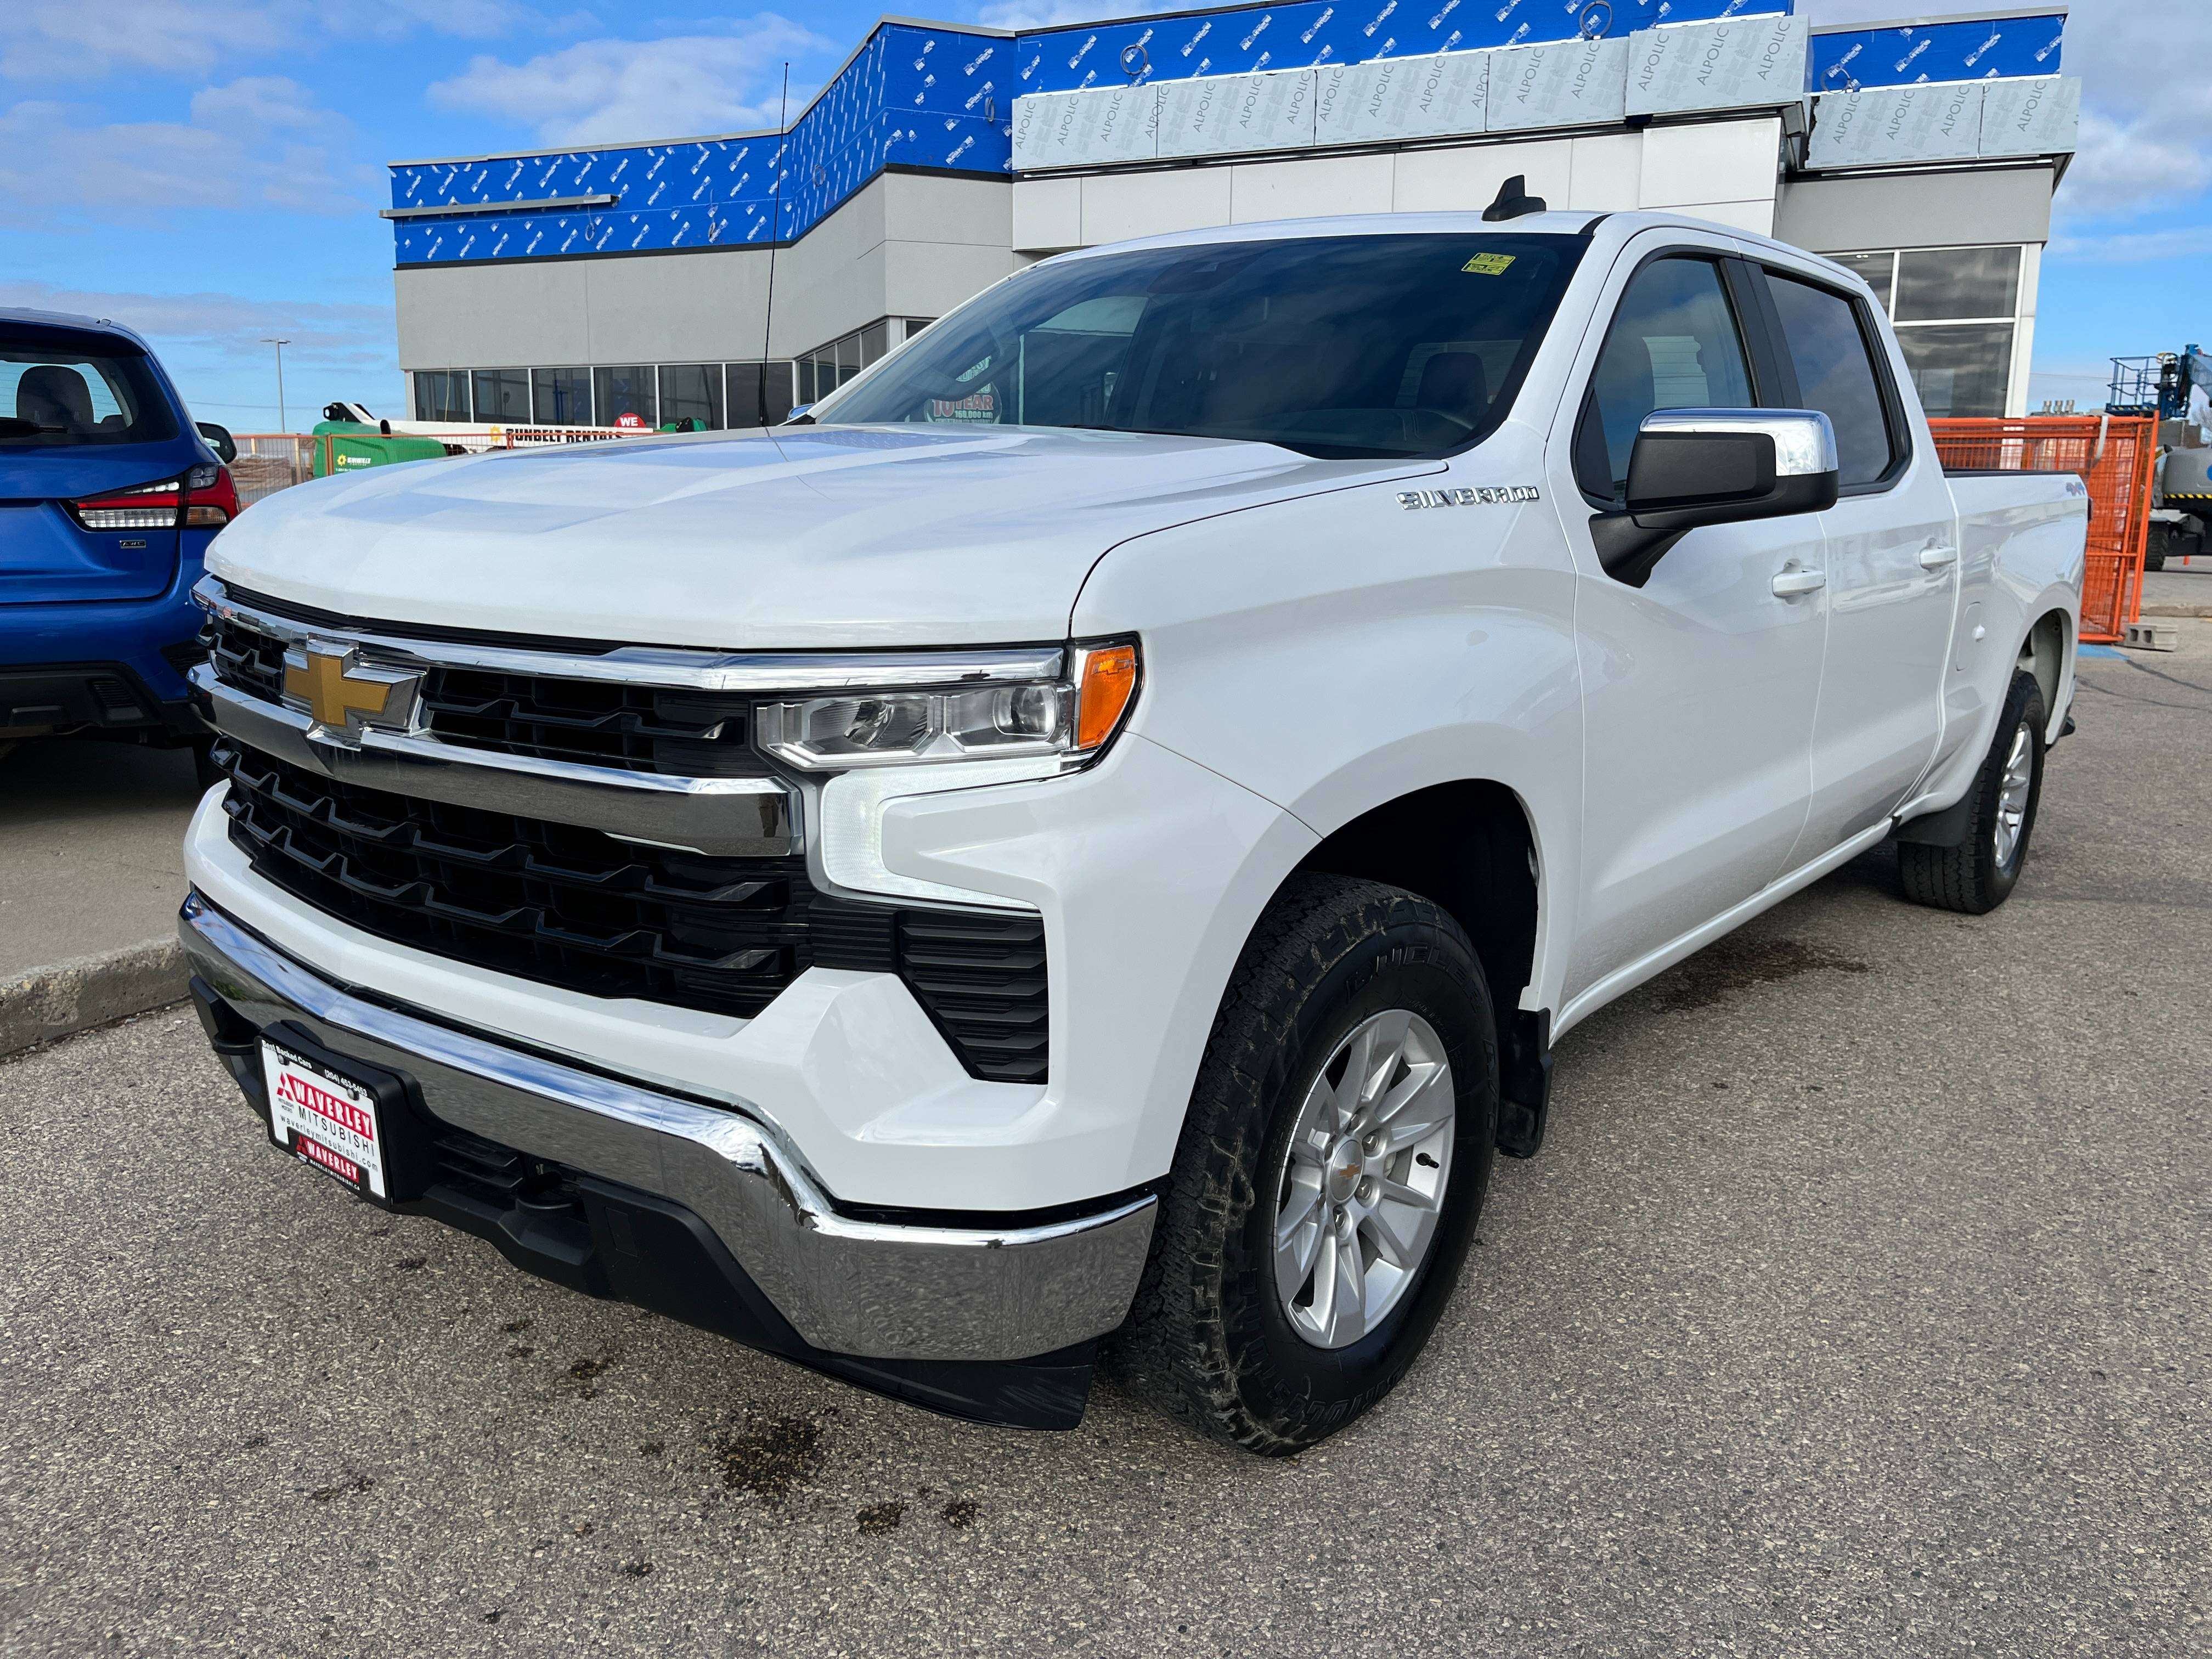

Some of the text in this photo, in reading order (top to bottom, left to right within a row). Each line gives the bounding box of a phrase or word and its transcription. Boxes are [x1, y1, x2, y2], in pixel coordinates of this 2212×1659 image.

[1516, 48, 1544, 104] ALPOLIC
[1571, 42, 1600, 99] ALPOLIC
[1638, 33, 1669, 91] ALPOLIC
[1696, 27, 1729, 86] ALPOLIC
[1757, 21, 1791, 80] ALPOLIC
[1145, 84, 1170, 138] ALPOLIC
[1193, 82, 1216, 133] ALPOLIC
[1239, 77, 1263, 128] ALPOLIC
[1287, 72, 1311, 125] ALPOLIC
[1319, 69, 1344, 122] ALPOLIC
[1368, 64, 1394, 117] ALPOLIC
[1420, 59, 1446, 113] ALPOLIC
[1940, 86, 1970, 136] ALPOLIC
[2017, 81, 2046, 132] ALPOLIC
[1015, 101, 1036, 149] ALPOLIC
[1057, 97, 1079, 146] ALPOLIC
[1101, 92, 1122, 142] ALPOLIC
[1833, 94, 1861, 144] ALPOLIC
[1886, 90, 1915, 140] ALPOLIC
[620, 417, 638, 427] WE
[1396, 486, 1540, 510] SILVERADO
[294, 1080, 371, 1137] WAVERLEY
[298, 1105, 375, 1156] MITSUBISHI
[280, 1114, 378, 1172] waverleymitsubishi.com
[307, 1141, 357, 1180] WAVERLEY
